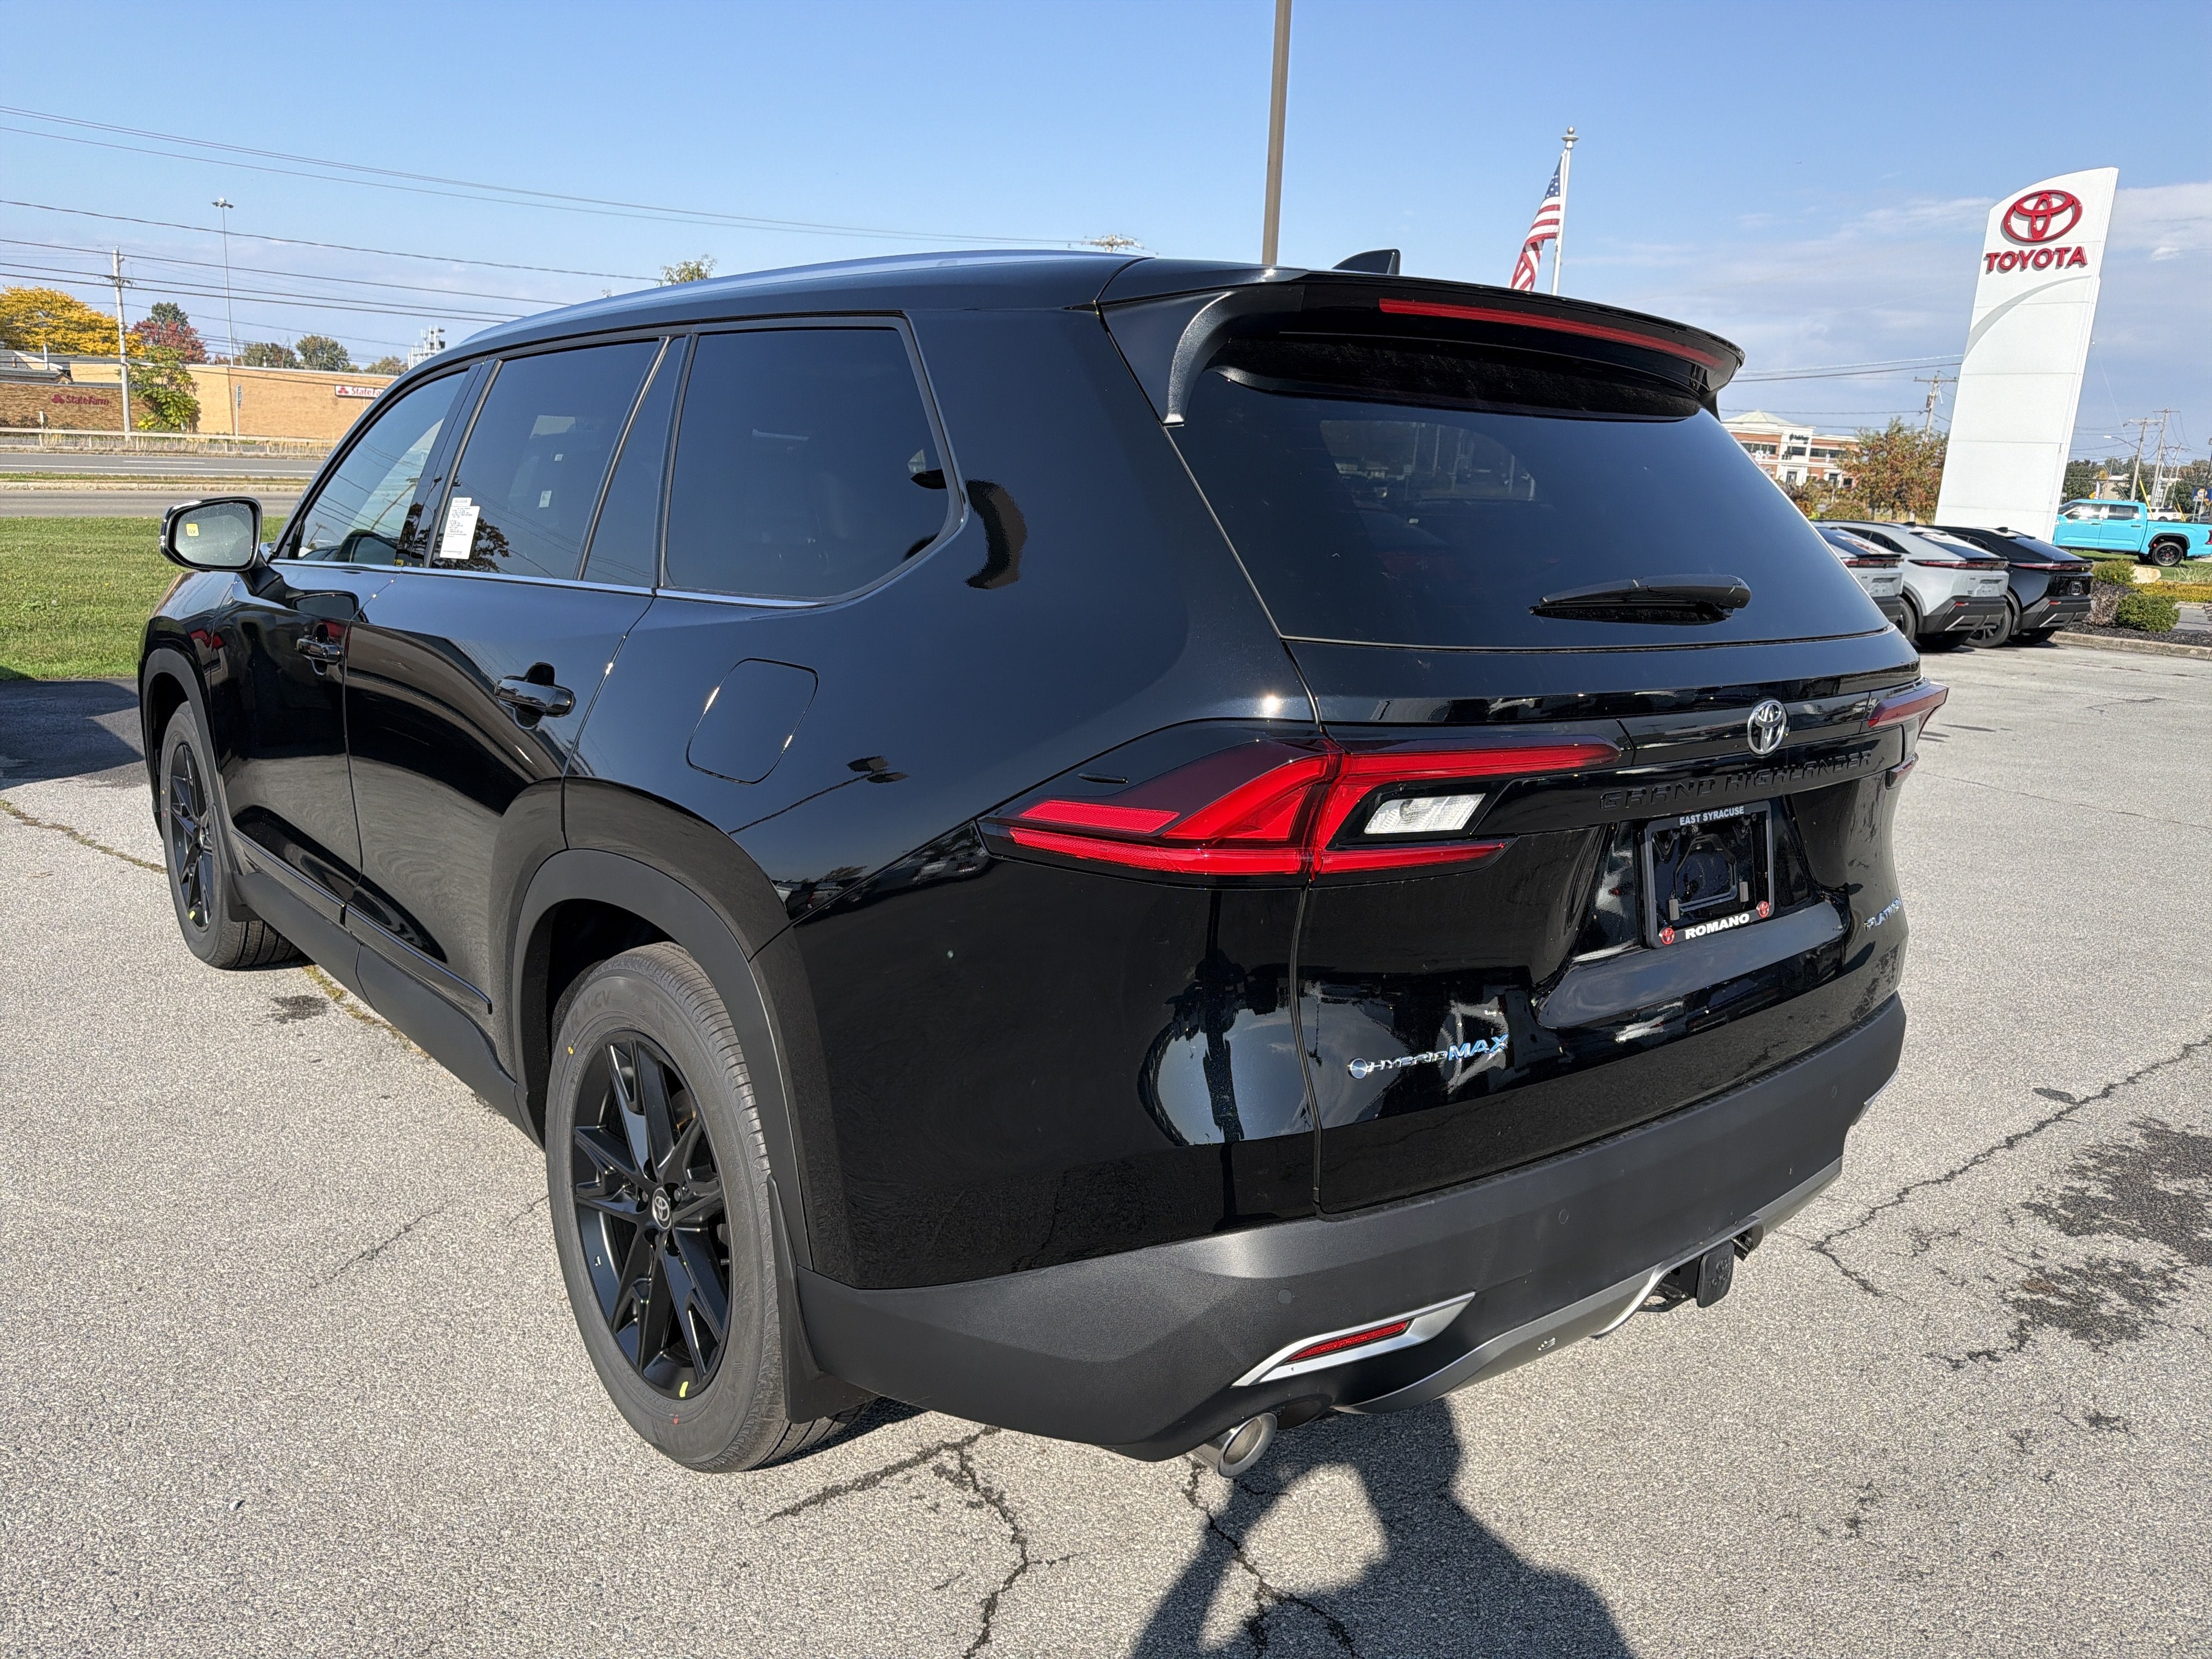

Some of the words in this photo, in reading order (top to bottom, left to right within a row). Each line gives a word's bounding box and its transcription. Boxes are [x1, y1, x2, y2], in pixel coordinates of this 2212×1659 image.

[1985, 246, 2088, 272] TOYOTA
[1600, 777, 1716, 810] GRAND
[1725, 749, 1871, 792] HIGHLANDER
[1679, 814, 1701, 826] EAST
[1702, 806, 1745, 822] SYRACUSE
[1684, 913, 1750, 940] ROMANO
